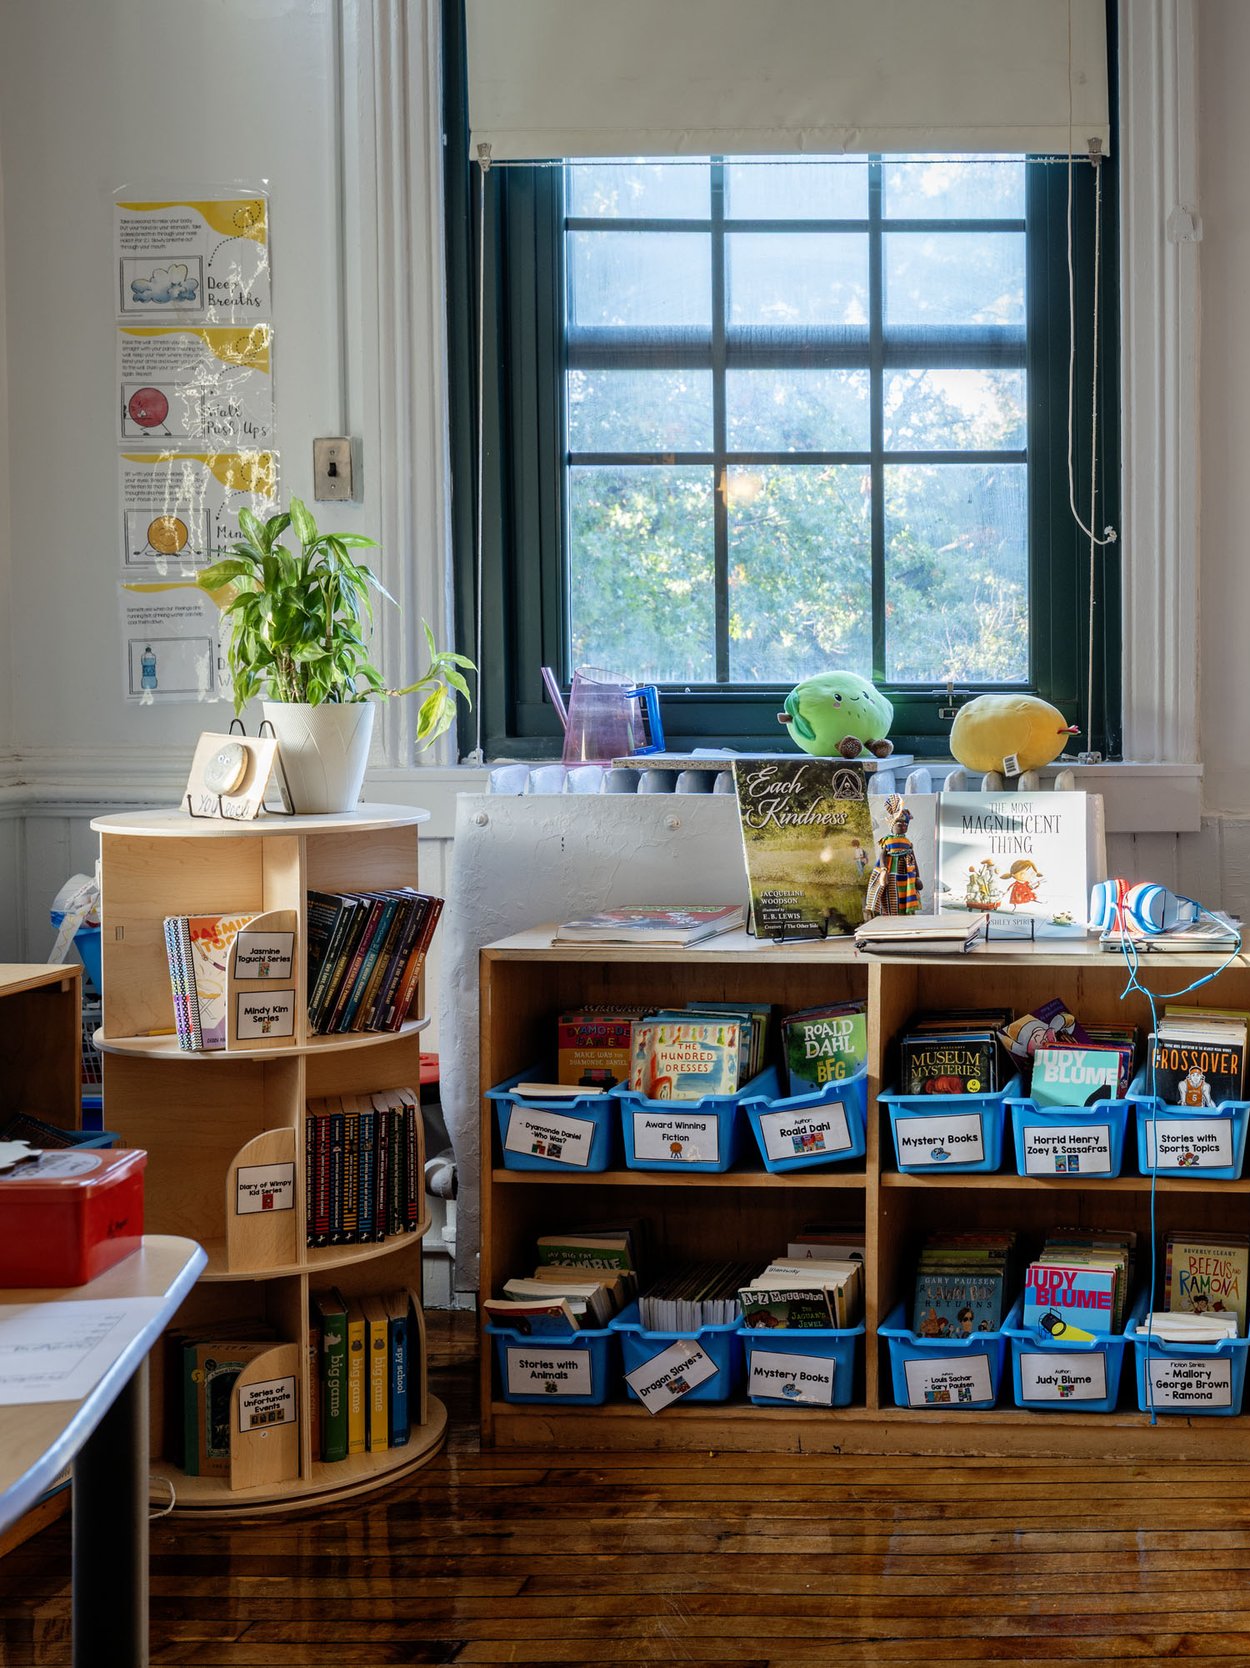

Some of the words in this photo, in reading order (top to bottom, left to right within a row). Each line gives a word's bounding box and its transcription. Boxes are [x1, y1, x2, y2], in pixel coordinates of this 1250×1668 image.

[746, 764, 810, 798] Each
[746, 795, 848, 829] Kindness
[990, 802, 1007, 815] THE
[1011, 802, 1034, 814] MOST
[962, 815, 1062, 834] MAGNIFICENT
[250, 947, 281, 955] Jasmine
[238, 955, 265, 964] Toguchi
[267, 955, 290, 963] Series
[244, 1006, 270, 1015] Mindy
[273, 1005, 289, 1013] Kim
[253, 1014, 280, 1023] Series
[803, 1019, 854, 1042] ROALD
[678, 1043, 697, 1051] THE
[804, 1036, 855, 1059] DAHL
[661, 1052, 713, 1061] HUNDRED
[911, 1050, 981, 1068] MUSEUM
[1034, 1050, 1088, 1068] JUDY
[665, 1064, 709, 1073] DRESSES
[817, 1057, 846, 1083] BFG
[911, 1064, 981, 1079] MYSTERIES
[1044, 1064, 1118, 1086] BLUME
[525, 1122, 560, 1136] Dyamonde
[561, 1129, 582, 1141] Daniel
[645, 1121, 673, 1129] Award
[674, 1122, 706, 1131] Winning
[780, 1126, 807, 1138] Roald
[809, 1122, 831, 1133] Dahl
[549, 1134, 567, 1144] Was?
[662, 1133, 690, 1141] Fiction
[902, 1136, 945, 1147] Mystery
[948, 1133, 978, 1144] Books
[1033, 1135, 1066, 1145] Horrid
[1069, 1135, 1100, 1145] Henry
[1161, 1134, 1194, 1143] Stories
[1197, 1134, 1217, 1143] with
[1027, 1146, 1050, 1155] Zoey
[1061, 1145, 1108, 1154] Sassafras
[1159, 1144, 1190, 1153] Sports
[1192, 1144, 1220, 1153] Topics
[1188, 1256, 1232, 1278] BEEZUS
[1025, 1268, 1078, 1290] JUDY
[1179, 1270, 1240, 1300] RAMONA
[1035, 1287, 1112, 1310] BLUME
[395, 1347, 403, 1364] spy
[328, 1354, 344, 1377] big
[519, 1359, 554, 1369] Stories
[557, 1360, 579, 1370] with
[397, 1365, 406, 1394] school
[530, 1370, 568, 1380] Animals
[639, 1374, 672, 1397] Dragon
[669, 1352, 703, 1376] Slayers
[753, 1367, 797, 1381] Mystery
[800, 1372, 830, 1384] Books
[931, 1376, 948, 1384] Louis
[949, 1375, 972, 1383] Sachar
[1036, 1376, 1058, 1385] Judy
[1061, 1375, 1092, 1384] Blume
[1172, 1369, 1212, 1379] Mallory
[949, 1382, 975, 1390] Paulsen
[1156, 1380, 1193, 1390] George
[1195, 1380, 1229, 1389] Brown
[250, 1388, 273, 1398] Series
[328, 1378, 340, 1417] game
[1172, 1391, 1213, 1400] Ramona
[244, 1393, 290, 1407] Unfortunate
[255, 1402, 280, 1413] Events
